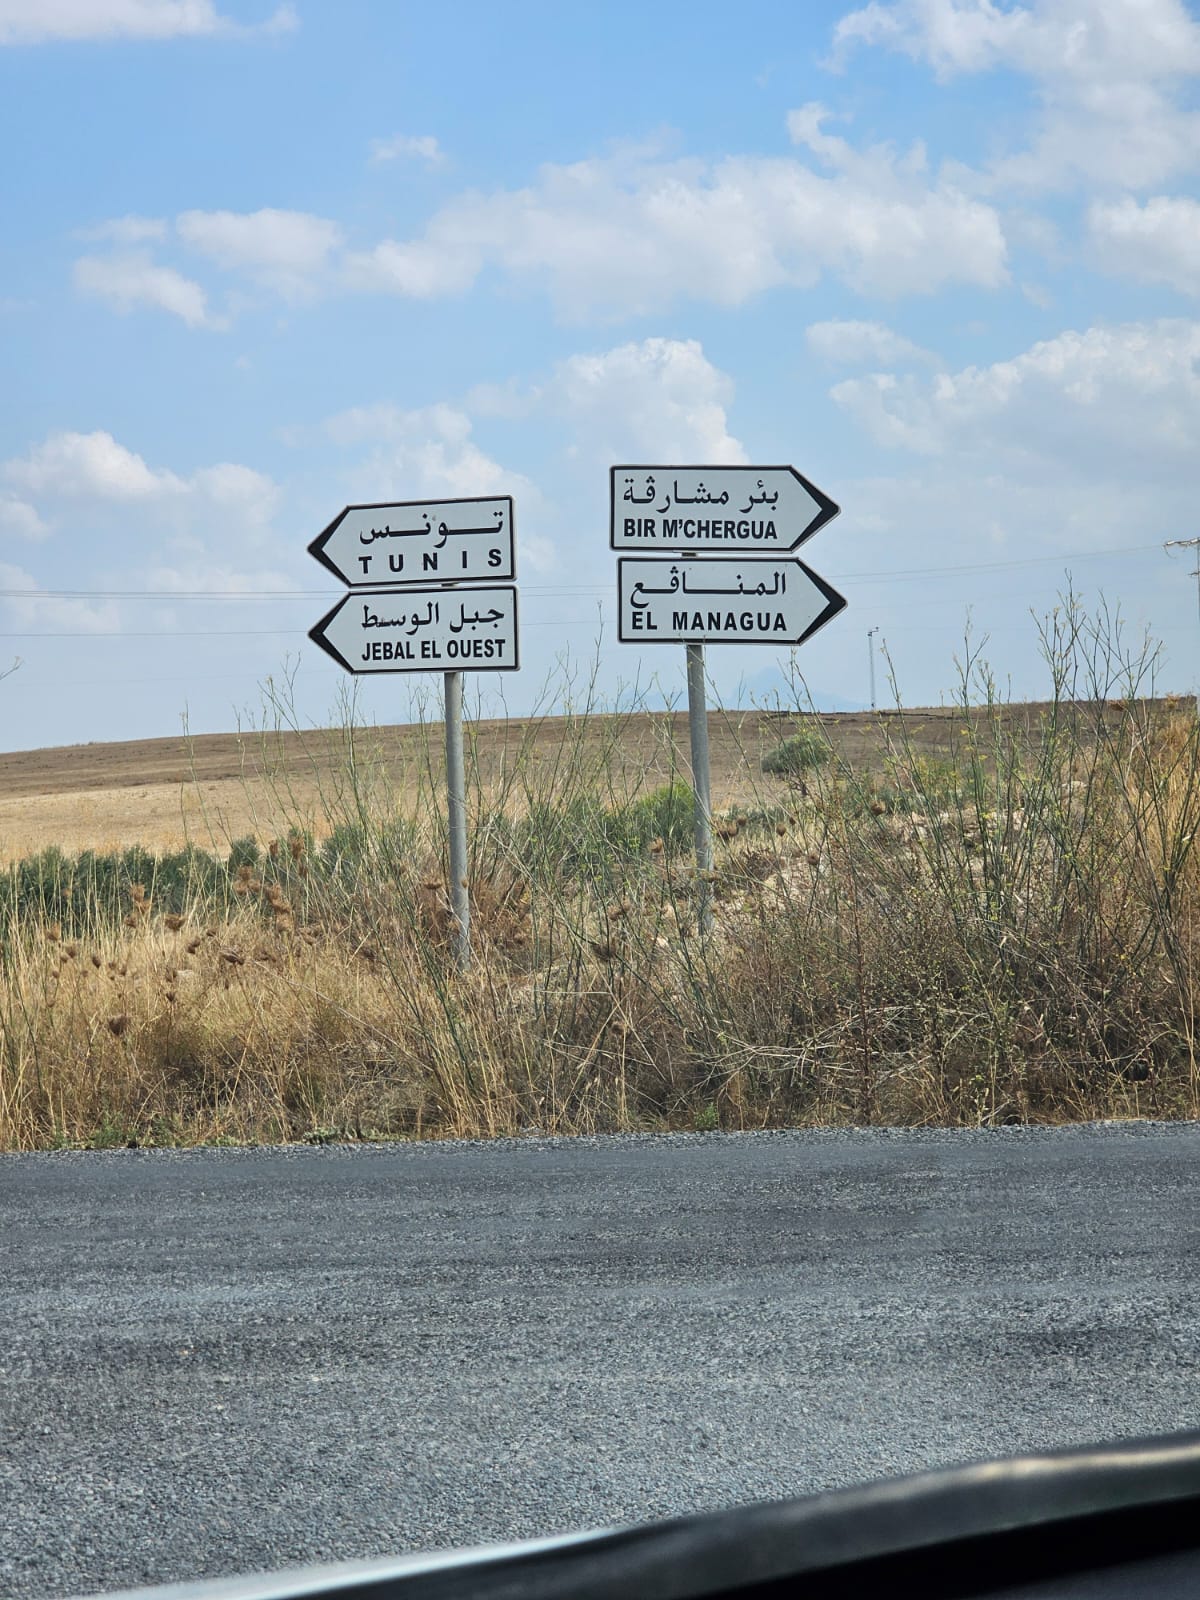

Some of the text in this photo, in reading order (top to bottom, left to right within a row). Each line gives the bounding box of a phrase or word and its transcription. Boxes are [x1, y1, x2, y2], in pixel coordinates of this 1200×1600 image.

[739, 479, 779, 514] بئر
[360, 511, 503, 548] تونس
[623, 519, 656, 537] BIR
[358, 549, 502, 574] TUNIS
[361, 602, 504, 635] جبل الوسط
[632, 611, 787, 631] EL MANAGUA
[362, 639, 505, 661] JEBAL EL OUEST
